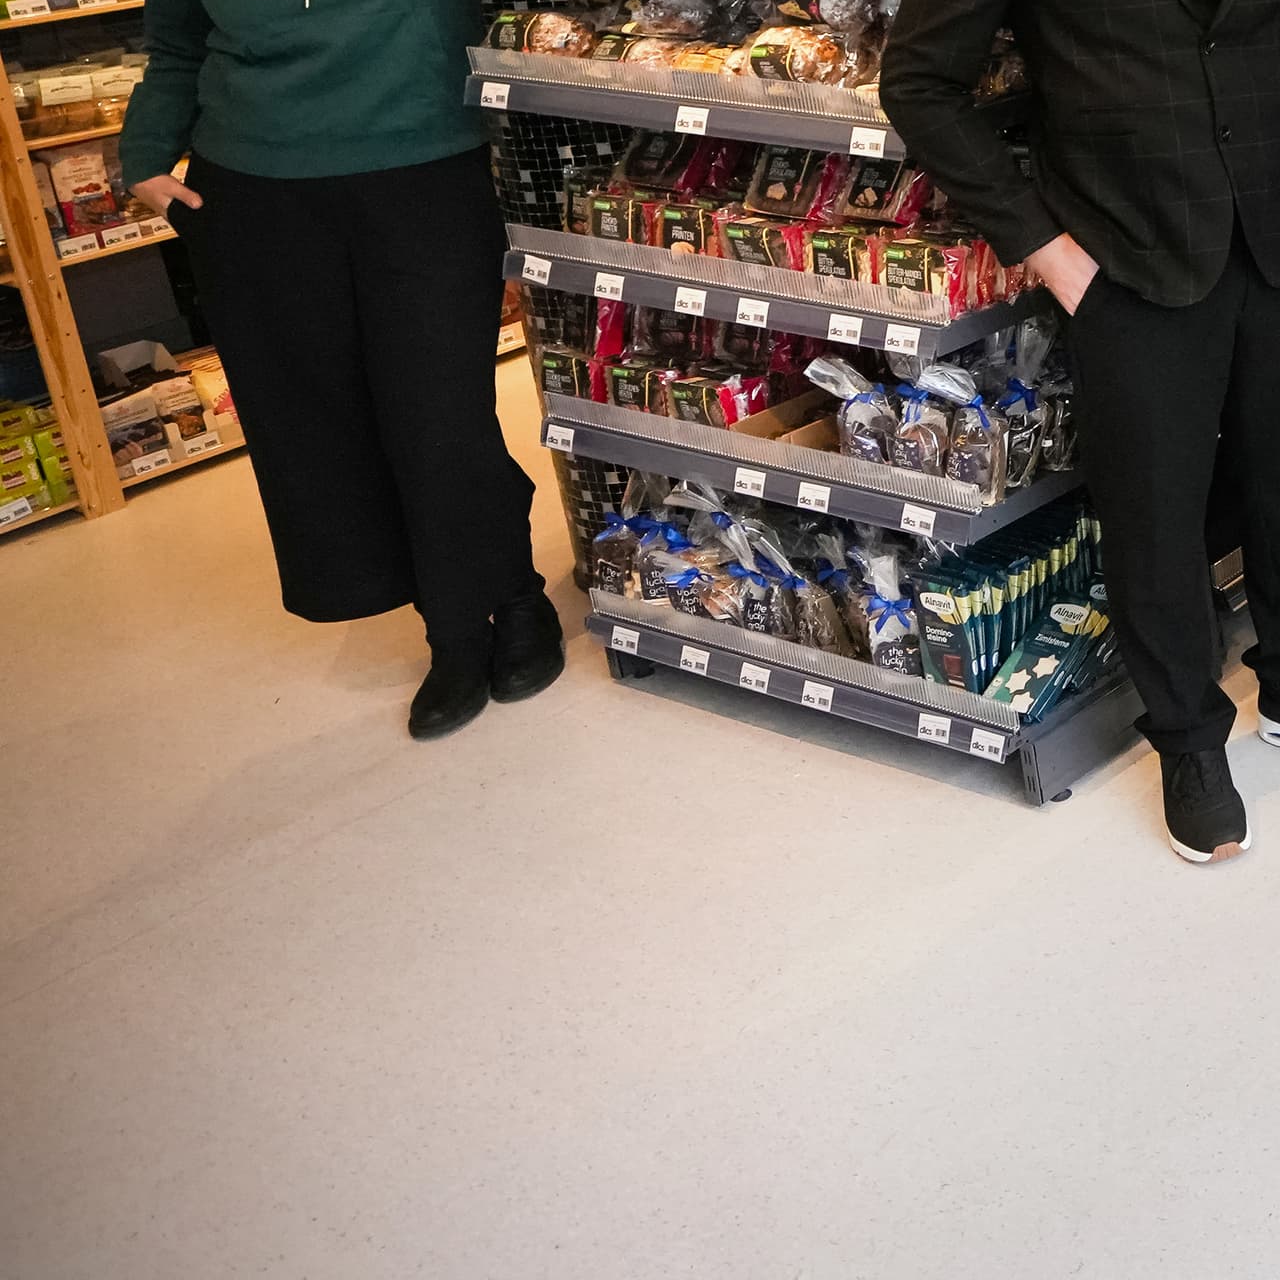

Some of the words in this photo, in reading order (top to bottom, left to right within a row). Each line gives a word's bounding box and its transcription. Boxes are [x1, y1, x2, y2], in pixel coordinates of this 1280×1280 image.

[672, 230, 694, 240] PRINTEN
[925, 595, 951, 609] Alnavit
[754, 603, 767, 613] the
[1055, 606, 1084, 621] Alnavit
[926, 626, 953, 638] Domino-
[927, 634, 948, 643] steine
[888, 648, 903, 658] the
[883, 656, 904, 668] lucky
